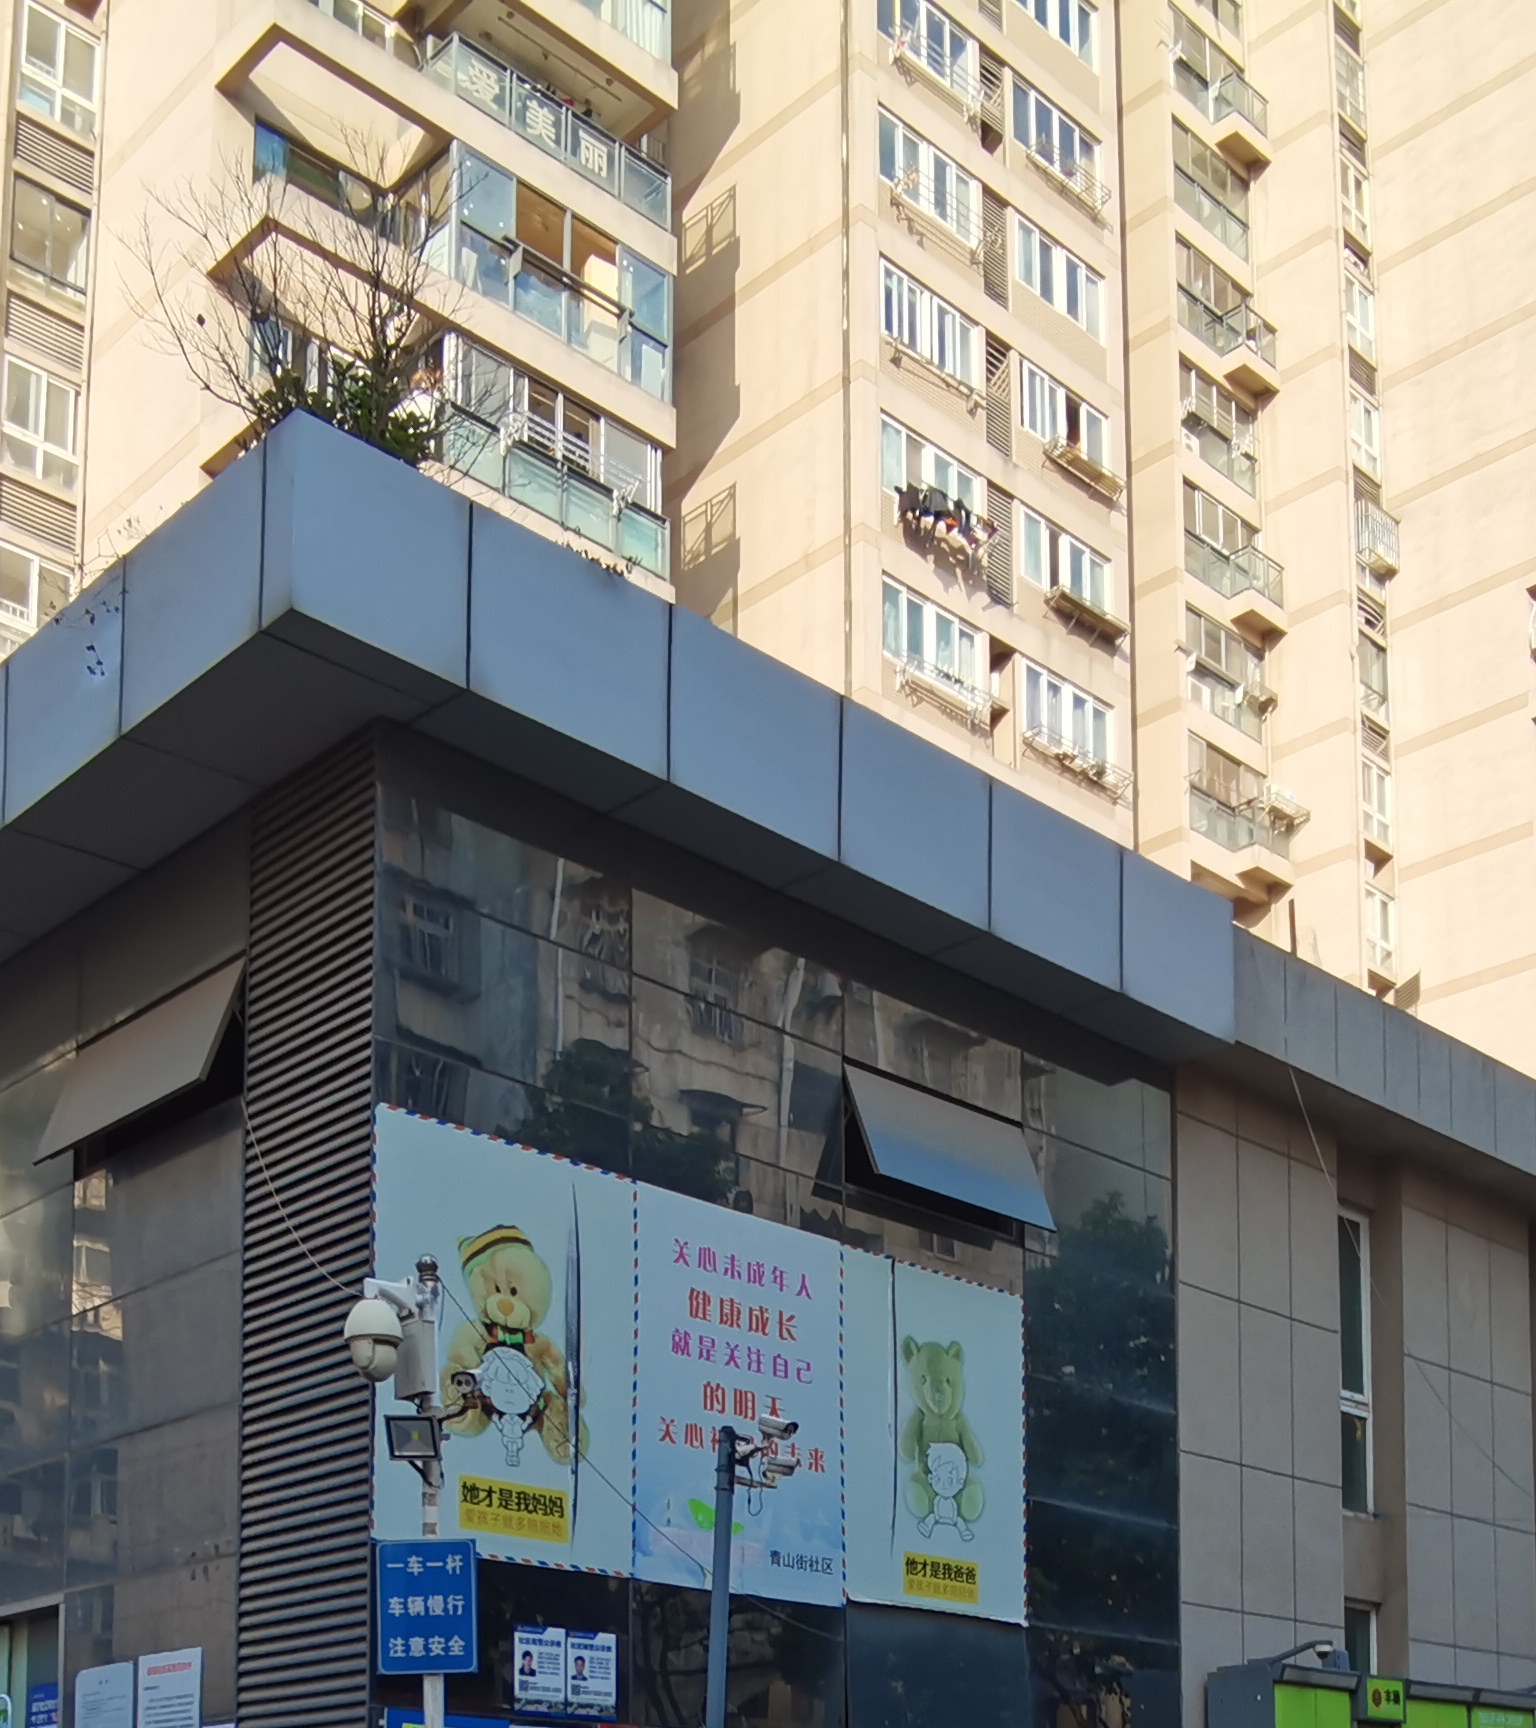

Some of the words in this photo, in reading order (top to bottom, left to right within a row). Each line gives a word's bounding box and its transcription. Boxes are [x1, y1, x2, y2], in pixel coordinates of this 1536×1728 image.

[671, 1237, 813, 1300] 关心未成年人
[687, 1286, 798, 1342] 健康成长
[670, 1327, 814, 1385] 就是关注自己
[702, 1380, 786, 1422] 的明天
[460, 1480, 565, 1519] 她才是我妈妈
[386, 1553, 464, 1576] 一车一杆
[769, 1549, 834, 1576] 青山街社区
[904, 1556, 977, 1586] 他才是我爸爸
[387, 1594, 466, 1617] 车辆慢行
[388, 1634, 466, 1658] 注意安全
